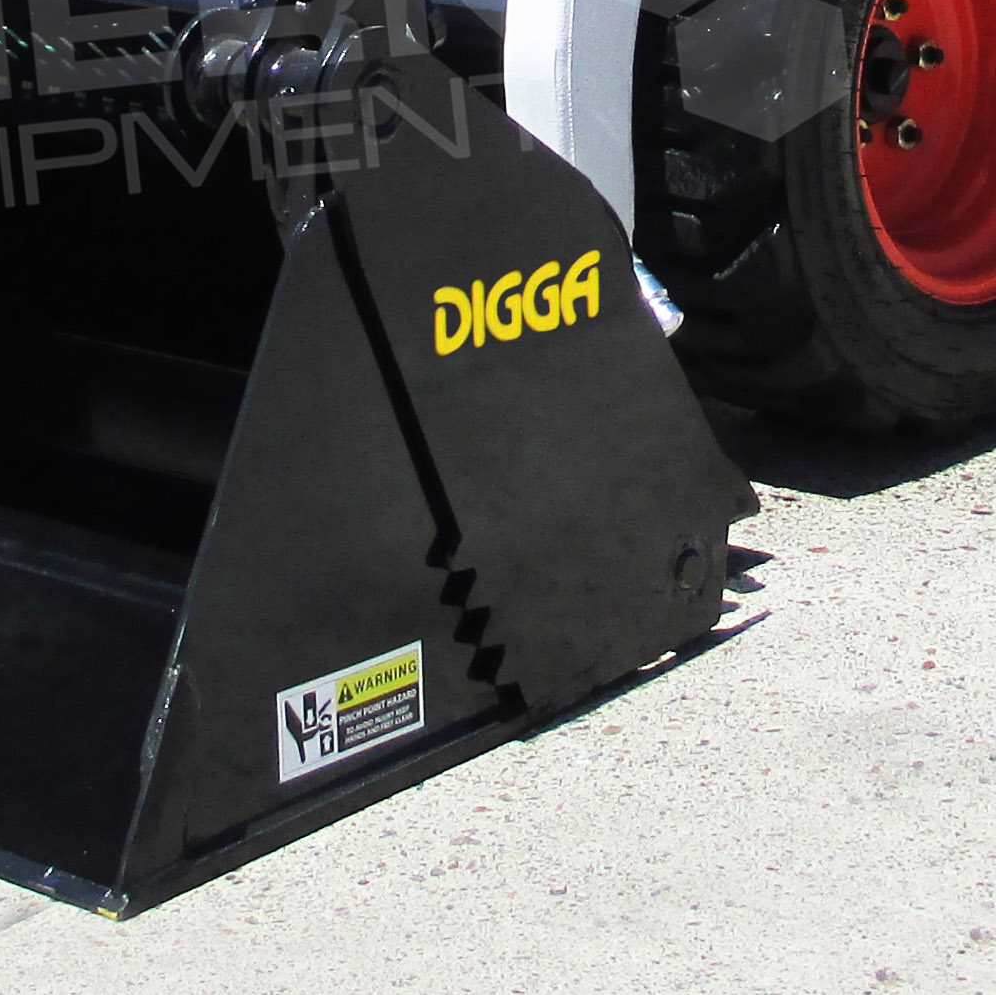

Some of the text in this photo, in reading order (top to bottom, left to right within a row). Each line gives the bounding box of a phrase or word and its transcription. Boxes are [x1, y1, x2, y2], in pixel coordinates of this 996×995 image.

[433, 249, 601, 357] DIGGA
[354, 660, 417, 694] WARNING
[364, 700, 387, 715] POINT
[387, 688, 417, 707] HAZARD
